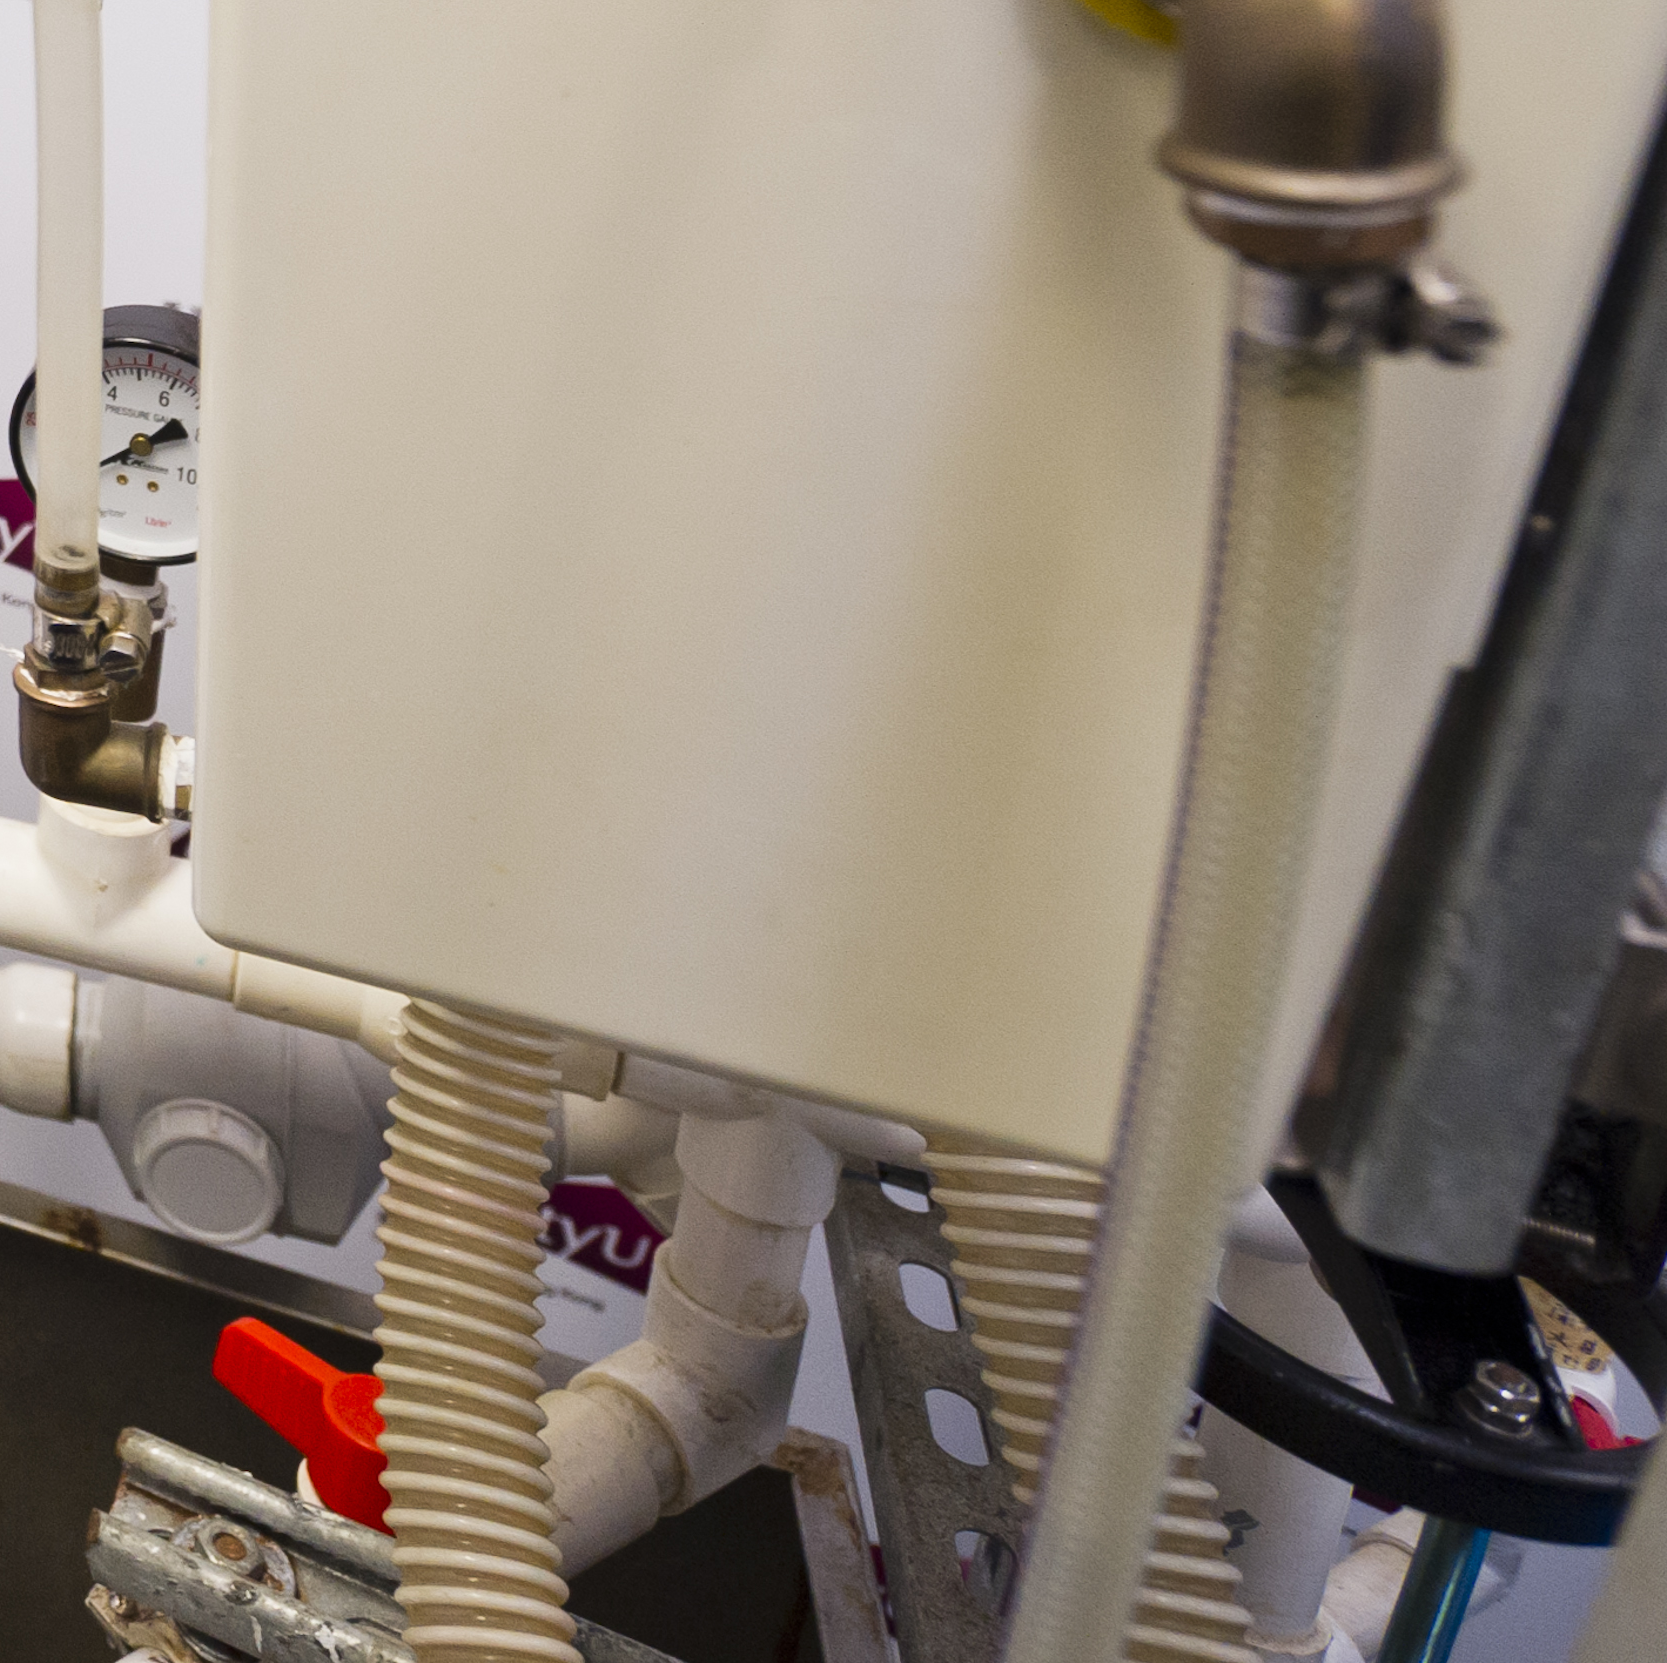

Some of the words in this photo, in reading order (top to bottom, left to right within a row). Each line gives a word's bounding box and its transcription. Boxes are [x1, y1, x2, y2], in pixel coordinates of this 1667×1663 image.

[106, 385, 118, 402] 4
[158, 390, 171, 408] 6
[104, 403, 151, 422] PRESSURE
[176, 465, 198, 485] 10
